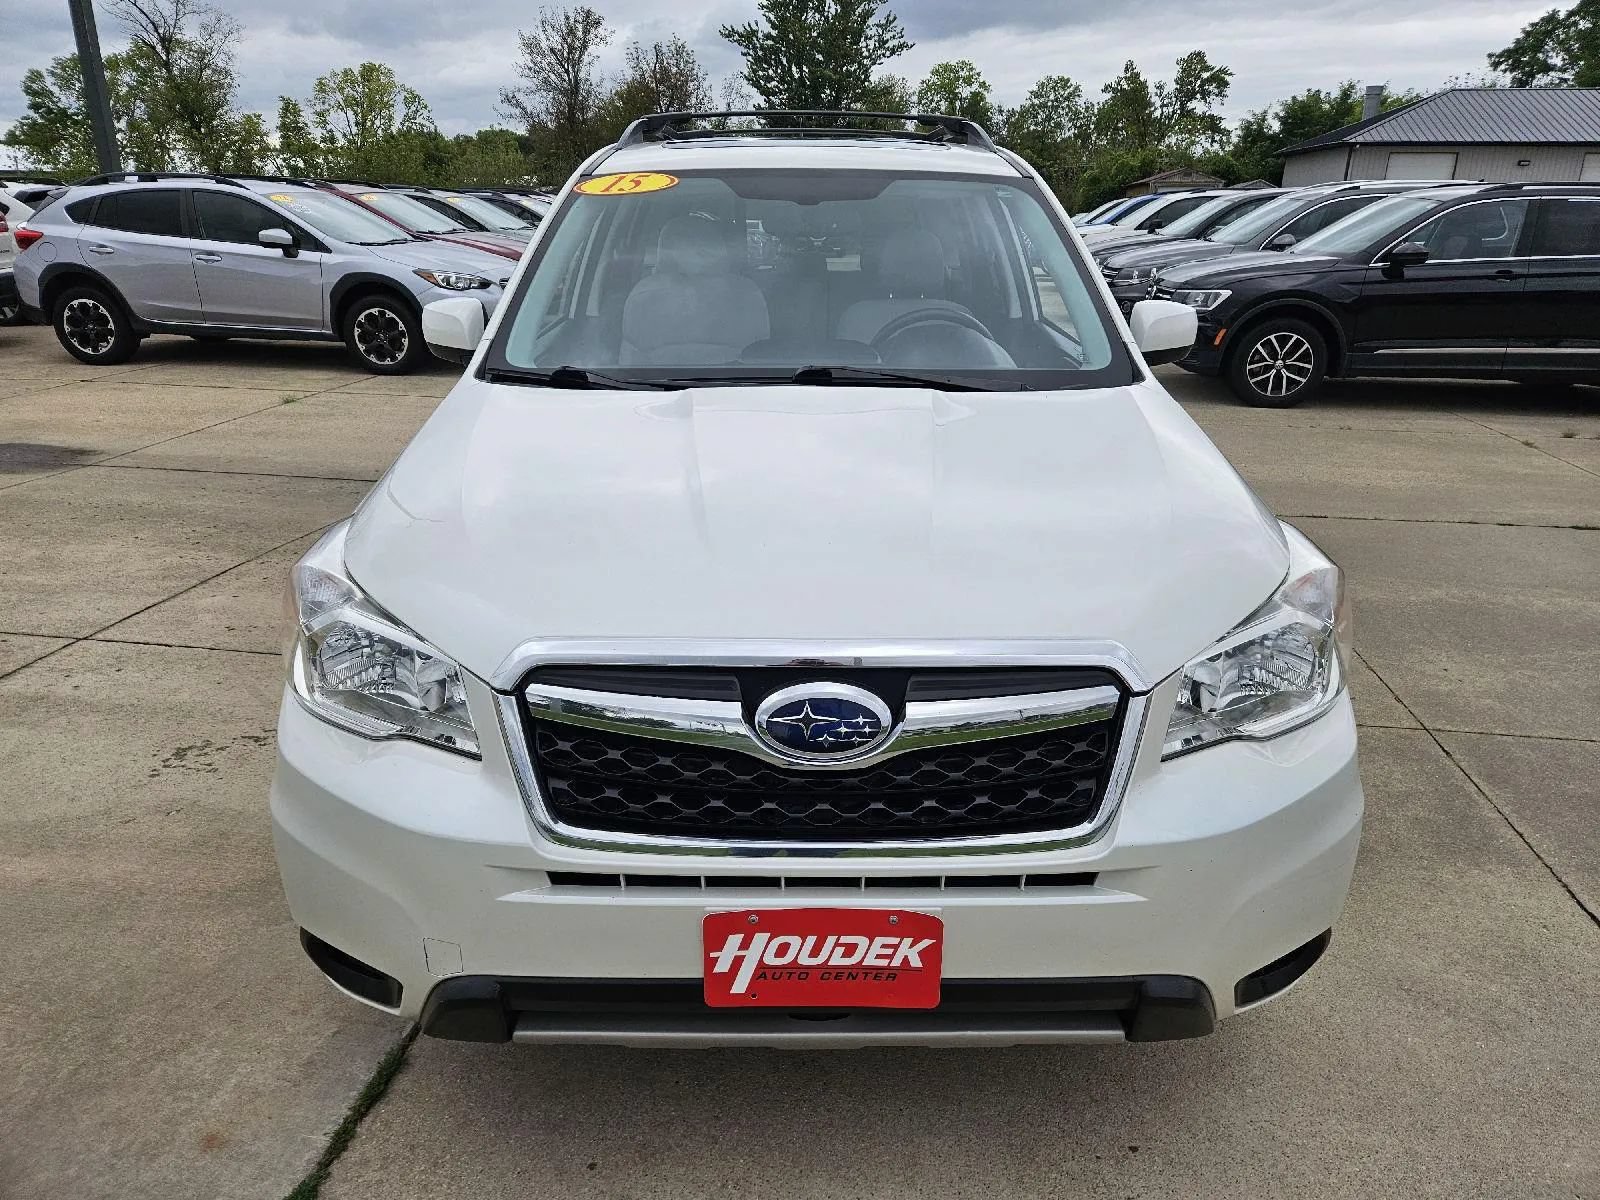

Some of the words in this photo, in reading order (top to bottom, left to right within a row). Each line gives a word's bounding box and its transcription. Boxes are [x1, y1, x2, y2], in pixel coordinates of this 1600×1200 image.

[600, 174, 652, 193] 15
[709, 932, 937, 994] HOUDEK
[755, 971, 809, 981] AUTO
[819, 971, 898, 982] CENTER
